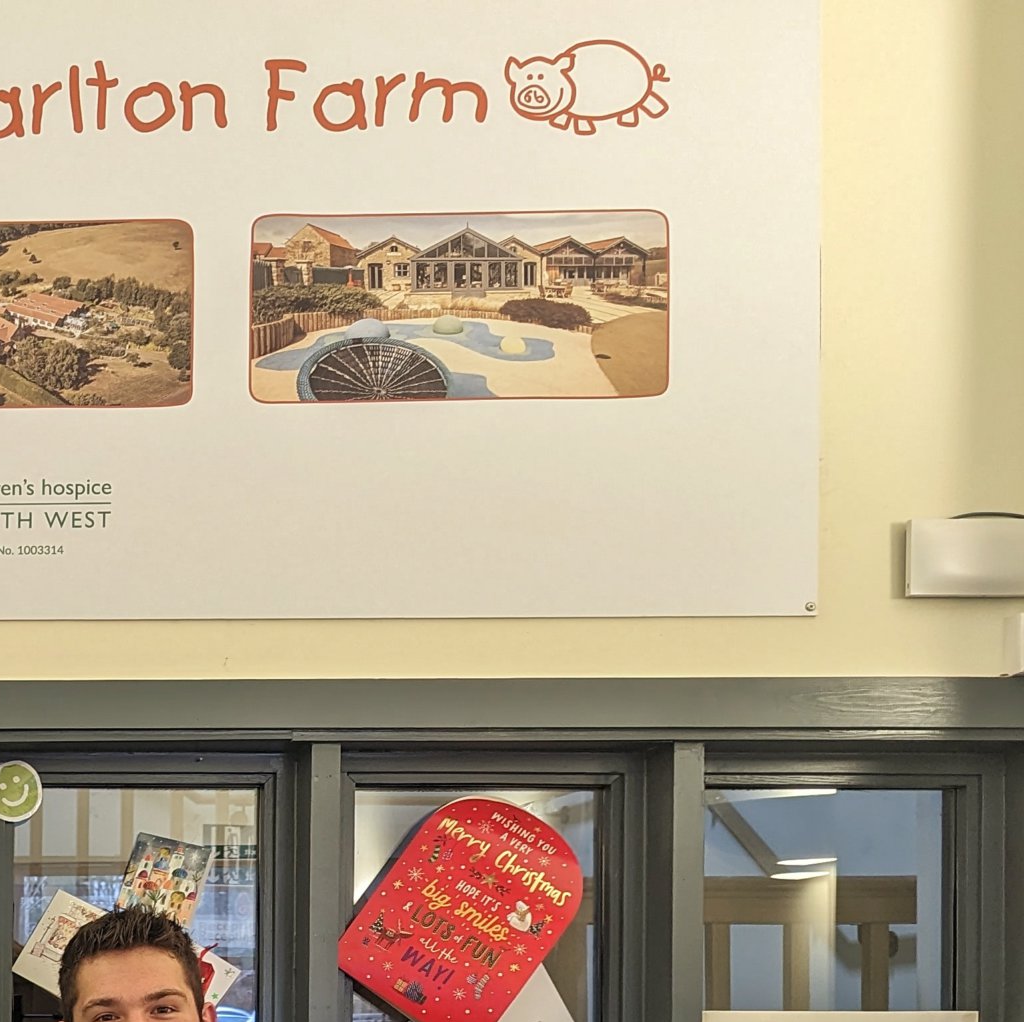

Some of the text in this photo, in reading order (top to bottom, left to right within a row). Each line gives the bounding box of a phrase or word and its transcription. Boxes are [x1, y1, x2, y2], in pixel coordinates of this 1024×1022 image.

[265, 59, 488, 131] Farm
[41, 478, 112, 500] hospice
[44, 511, 112, 529] WEST
[18, 545, 64, 555] 1003314
[491, 811, 557, 855] WISHING YOU
[499, 832, 534, 855] A VERY
[436, 816, 572, 906] Merry Christmas
[421, 879, 510, 941] big smiles
[455, 879, 502, 912] HOPE IT'S
[410, 904, 456, 941] LOTS
[460, 935, 502, 970] FUN
[419, 937, 458, 964] all the
[400, 946, 456, 991] WAY!
